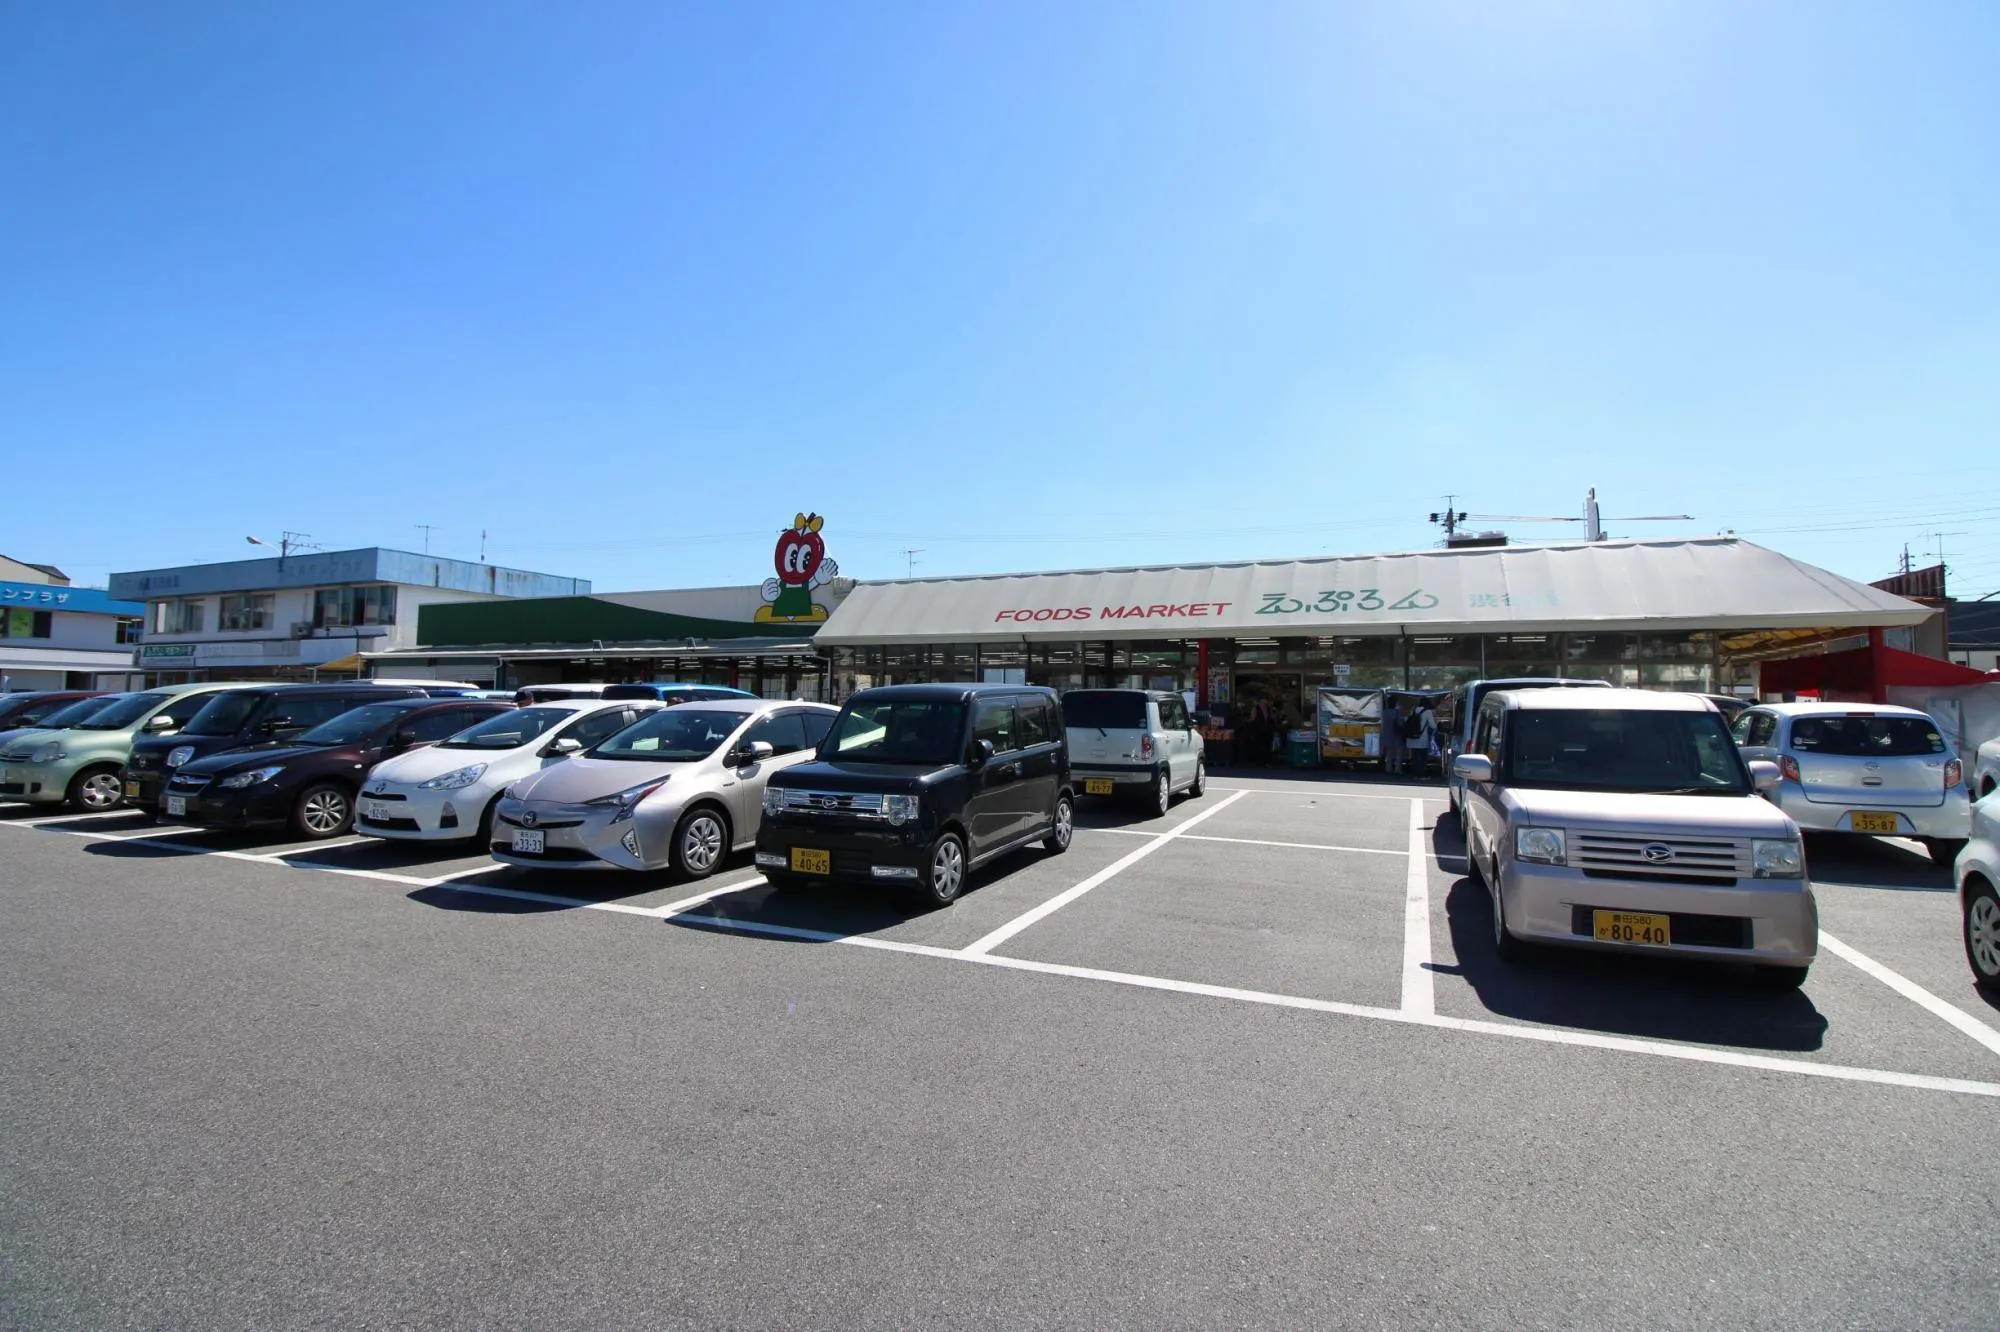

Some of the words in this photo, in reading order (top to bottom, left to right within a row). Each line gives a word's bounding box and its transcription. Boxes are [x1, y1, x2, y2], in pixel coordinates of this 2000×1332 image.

[995, 607, 1092, 622] FOODS
[1100, 602, 1233, 619] MARKET
[800, 858, 828, 872] 40-65
[1611, 924, 1665, 944] 80-40
